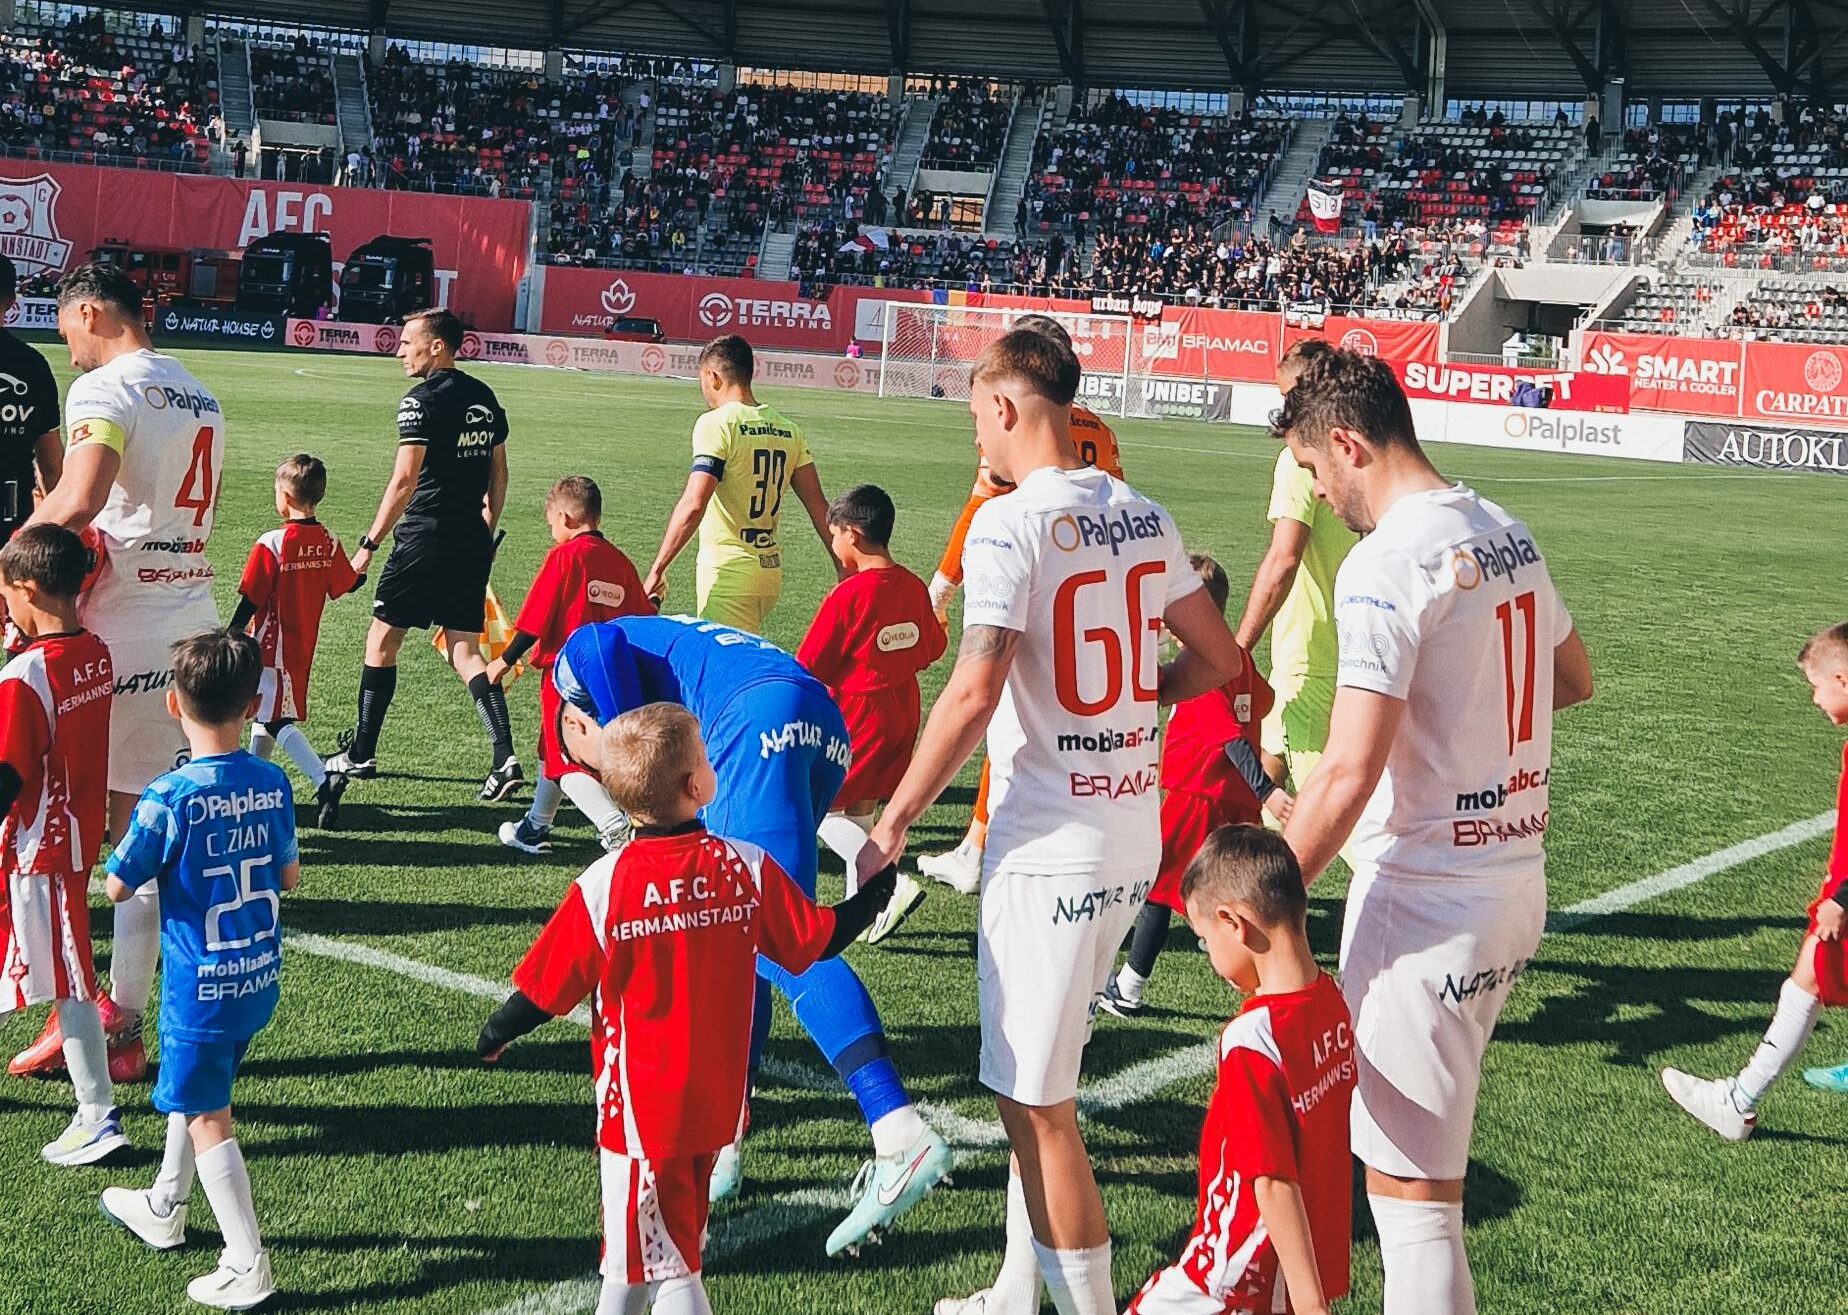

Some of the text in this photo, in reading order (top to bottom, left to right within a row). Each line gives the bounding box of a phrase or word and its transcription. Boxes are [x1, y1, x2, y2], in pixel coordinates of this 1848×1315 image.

[238, 189, 333, 247] AFC
[735, 298, 837, 320] TERRA
[1092, 293, 1163, 317] urban boys
[180, 316, 260, 336] NATUR HOUSE
[319, 328, 360, 339] TERRA
[738, 316, 837, 330] BUILDING
[485, 340, 528, 352] TERRA
[572, 347, 619, 359] TERRA
[1182, 334, 1269, 354] BRAMAC
[765, 361, 814, 374] TERRA
[1635, 354, 1738, 385] SMART
[1141, 380, 1219, 405] UNIBET
[1634, 378, 1737, 397] HEATER & COOLER
[1528, 415, 1622, 449] Palplast
[174, 426, 214, 526] 4
[749, 449, 787, 519] 37
[1077, 509, 1164, 556] Palplast
[1471, 532, 1541, 584] Palpla
[73, 658, 111, 686] A.F.C.
[1496, 590, 1536, 757] 11
[759, 719, 822, 760] NATUR
[206, 787, 284, 823] Palplast
[202, 854, 280, 952] 25
[643, 876, 716, 908] A.F.C.
